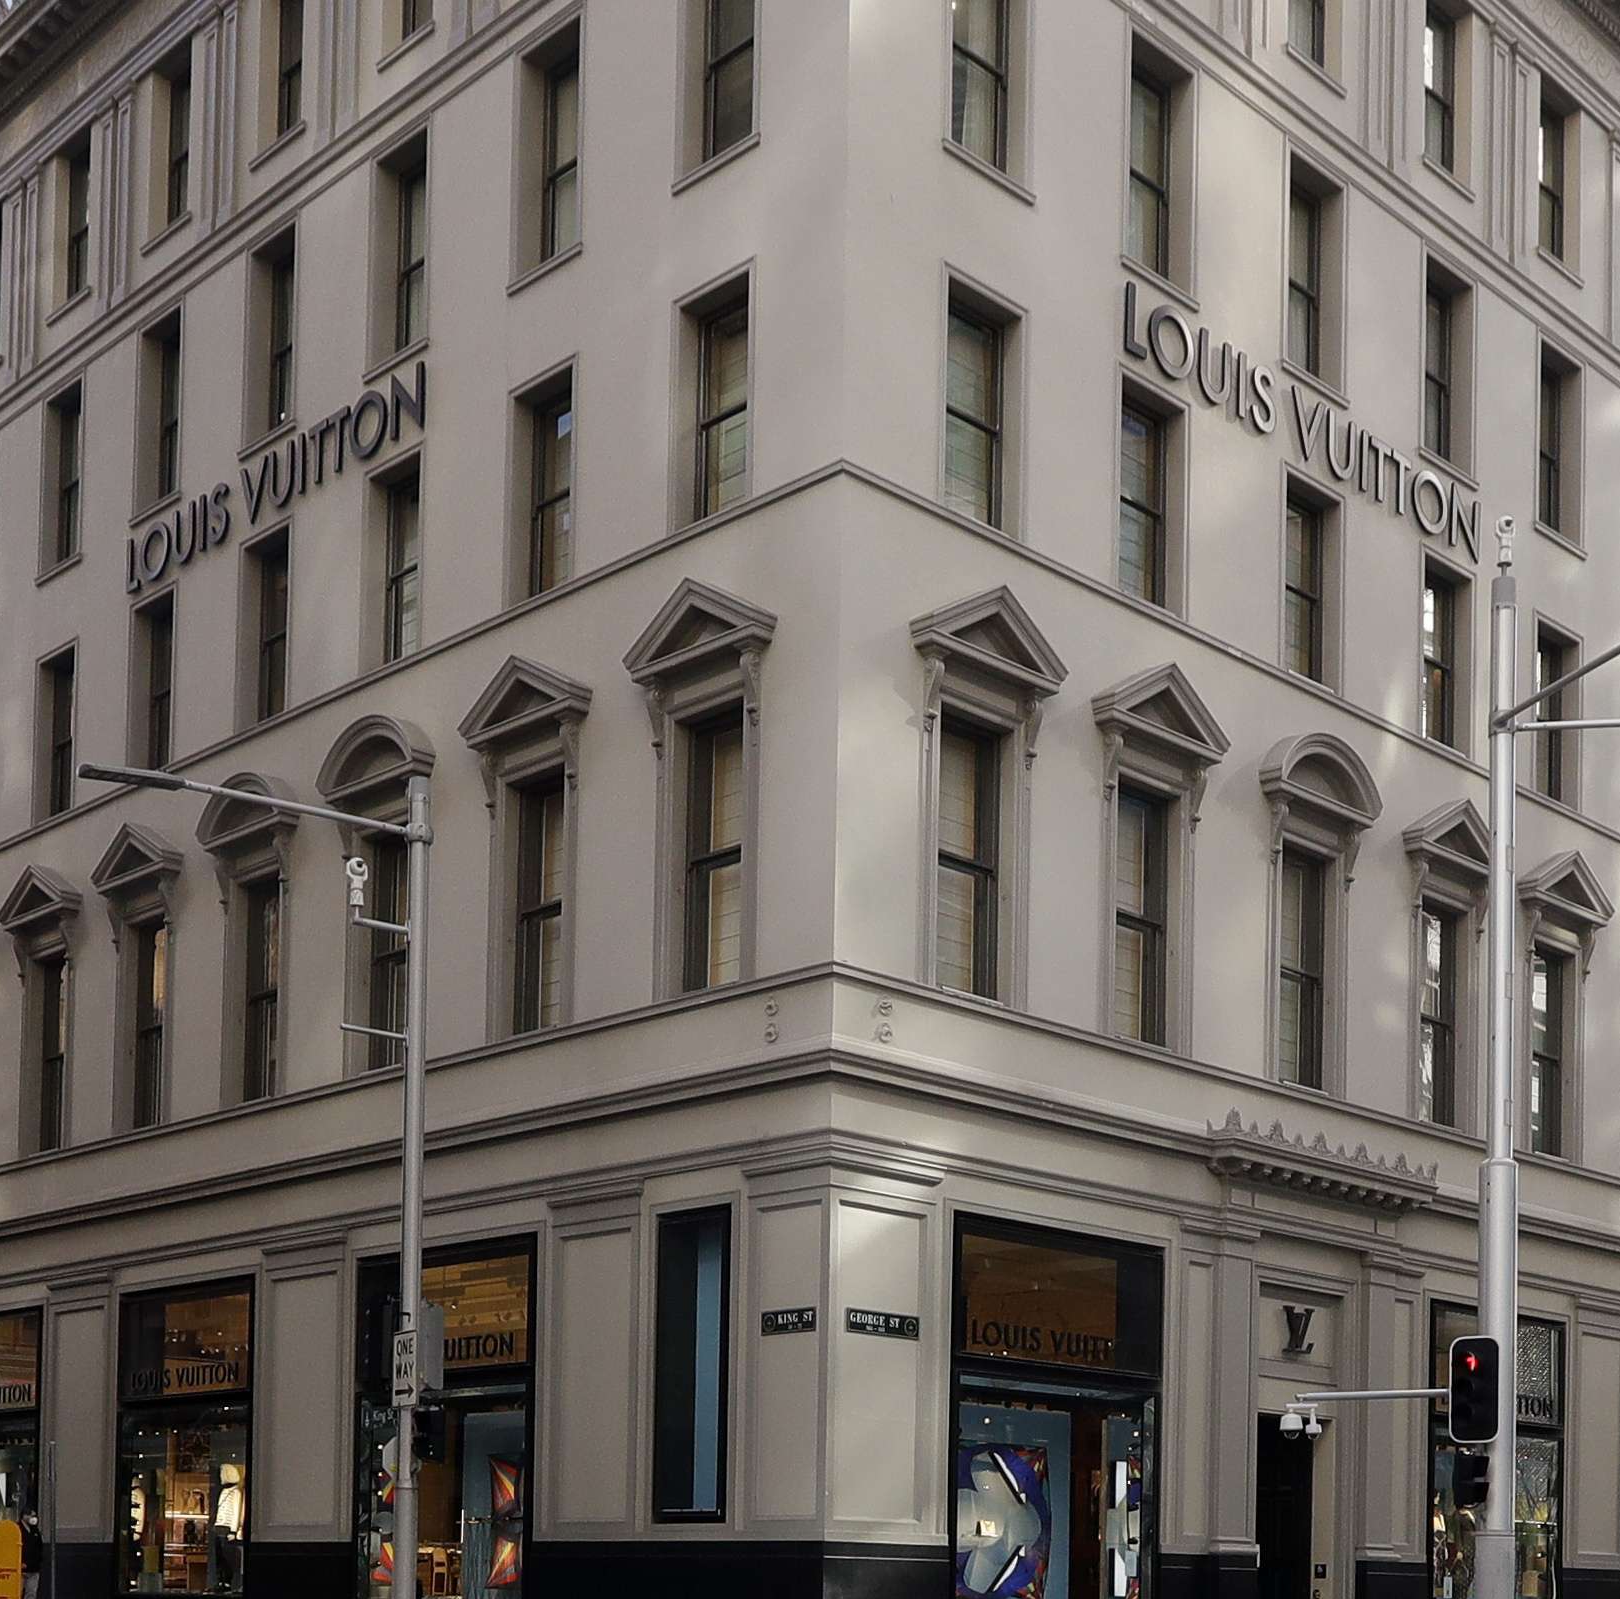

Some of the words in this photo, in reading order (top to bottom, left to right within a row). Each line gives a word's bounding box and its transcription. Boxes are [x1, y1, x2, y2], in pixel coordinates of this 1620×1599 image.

[1124, 281, 1277, 434] LOUIS
[1291, 384, 1481, 565] VUITTON
[126, 482, 229, 594] LOUIS
[240, 360, 426, 525] VUITTON
[777, 1312, 799, 1326] KING
[803, 1310, 814, 1323] ST
[850, 1311, 886, 1327] GEORGE
[889, 1316, 901, 1329] ST
[396, 1337, 414, 1357] ONE
[444, 1331, 514, 1362] UITTON
[971, 1318, 1043, 1352] LOUIS
[131, 1367, 171, 1391] LOUIS
[176, 1361, 238, 1388] VUITTON
[395, 1362, 415, 1380] WAY
